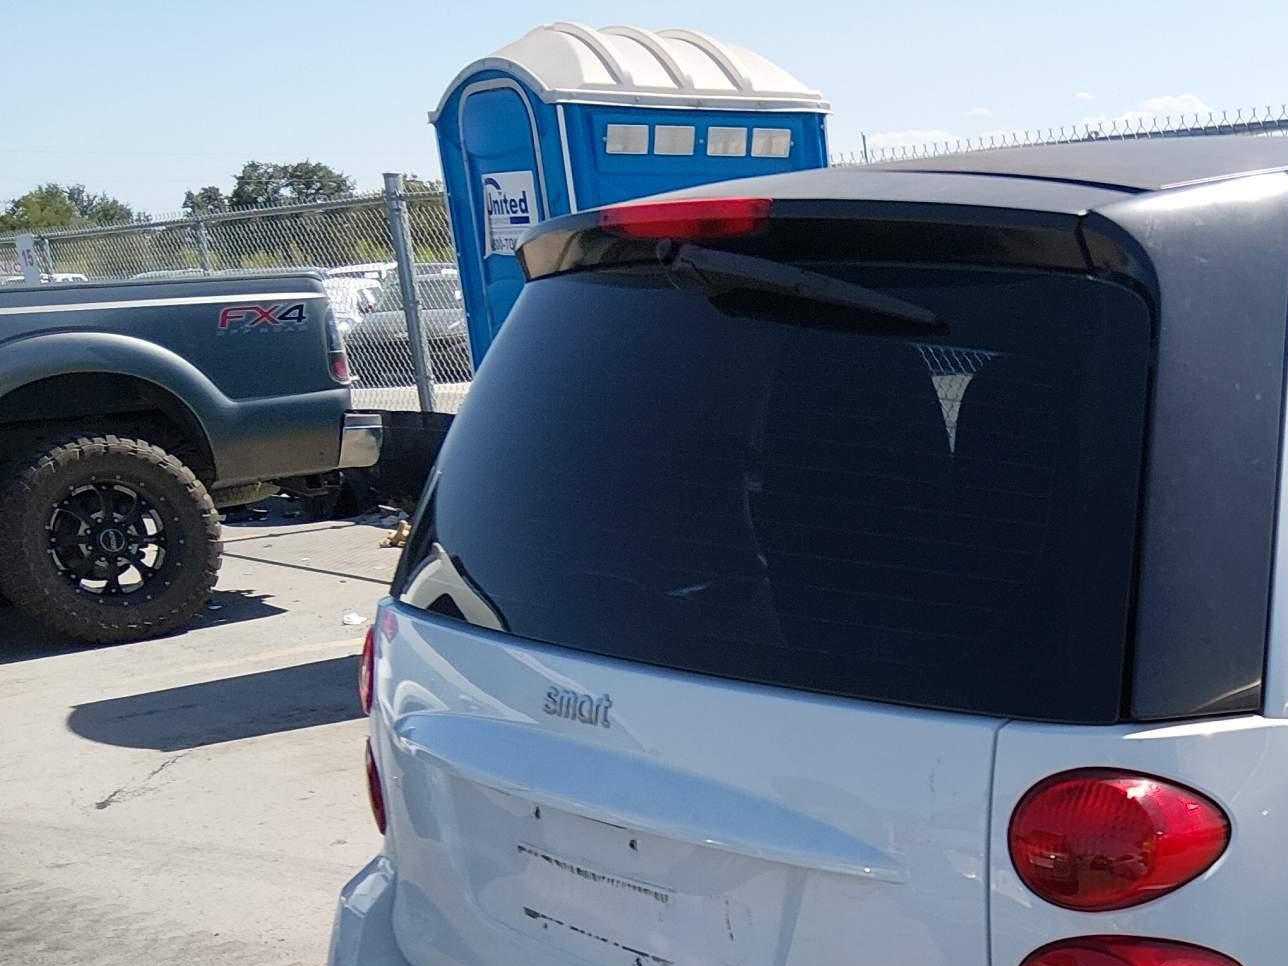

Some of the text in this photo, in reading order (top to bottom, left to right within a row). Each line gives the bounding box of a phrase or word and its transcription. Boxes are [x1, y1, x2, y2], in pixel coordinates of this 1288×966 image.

[487, 190, 529, 215] United
[218, 303, 307, 330] FX4
[543, 686, 613, 729] smart
